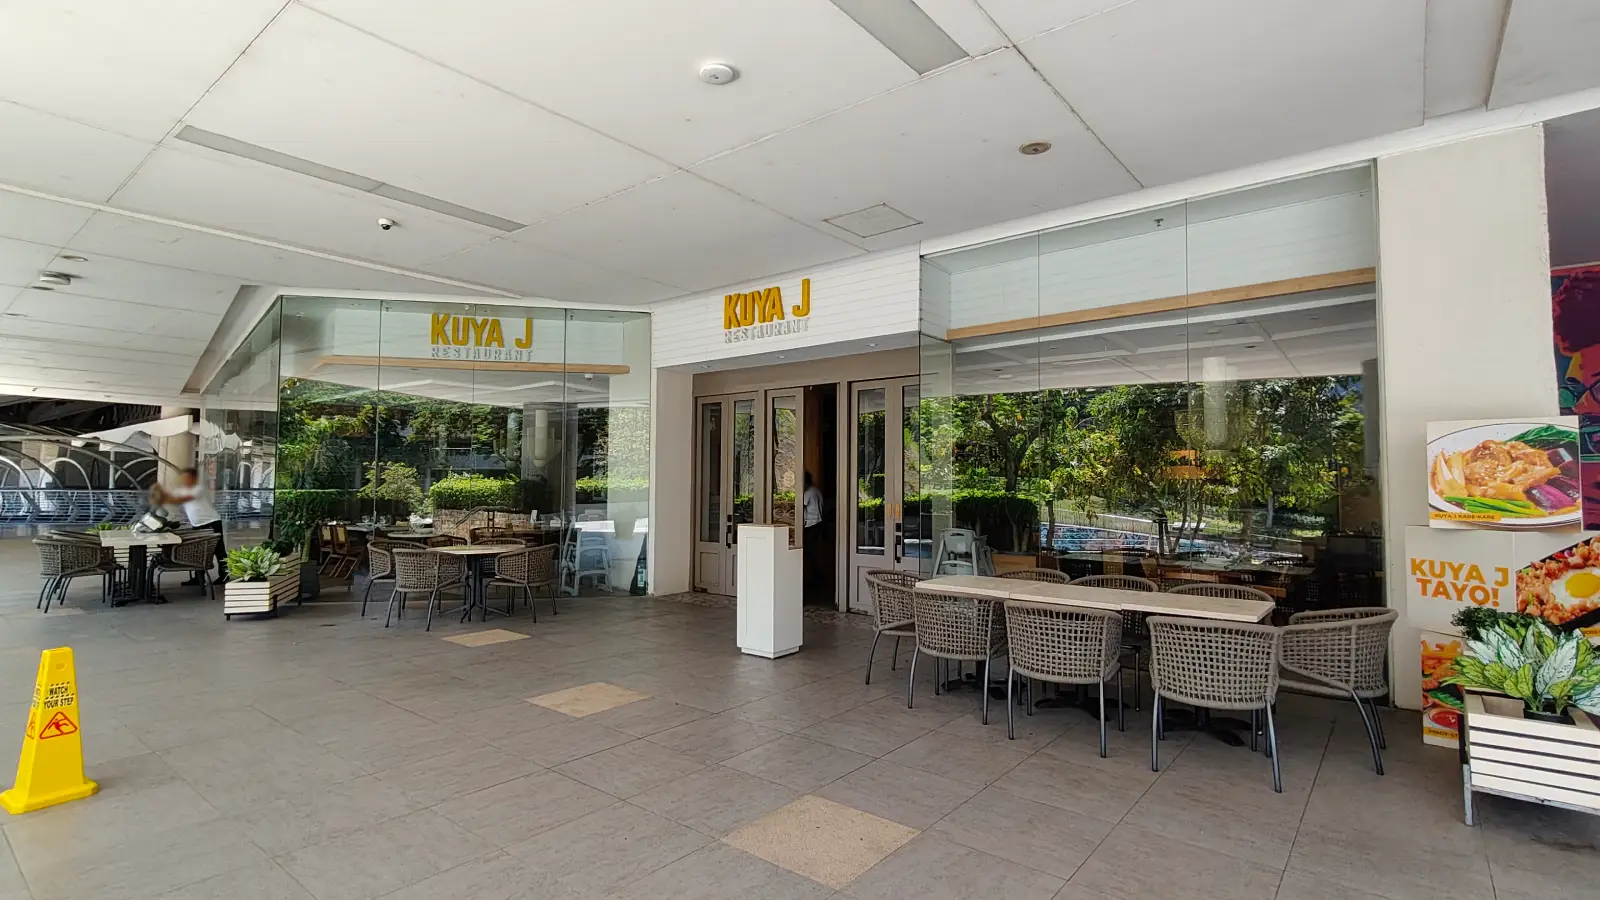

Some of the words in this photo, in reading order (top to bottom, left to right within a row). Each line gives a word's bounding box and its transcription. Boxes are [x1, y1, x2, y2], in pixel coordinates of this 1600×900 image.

[724, 286, 785, 330] KUYA
[792, 278, 811, 317] J
[430, 312, 505, 349] KUYA
[514, 317, 534, 350] J
[724, 317, 811, 344] RESTAURANT
[431, 346, 534, 362] RESTAURANT
[1410, 557, 1487, 585] KUYA
[1494, 566, 1509, 588] J
[1416, 577, 1500, 608] TAYO!
[44, 699, 59, 710] YOUR
[60, 696, 74, 707] STEP
[49, 685, 69, 696] WATCH
